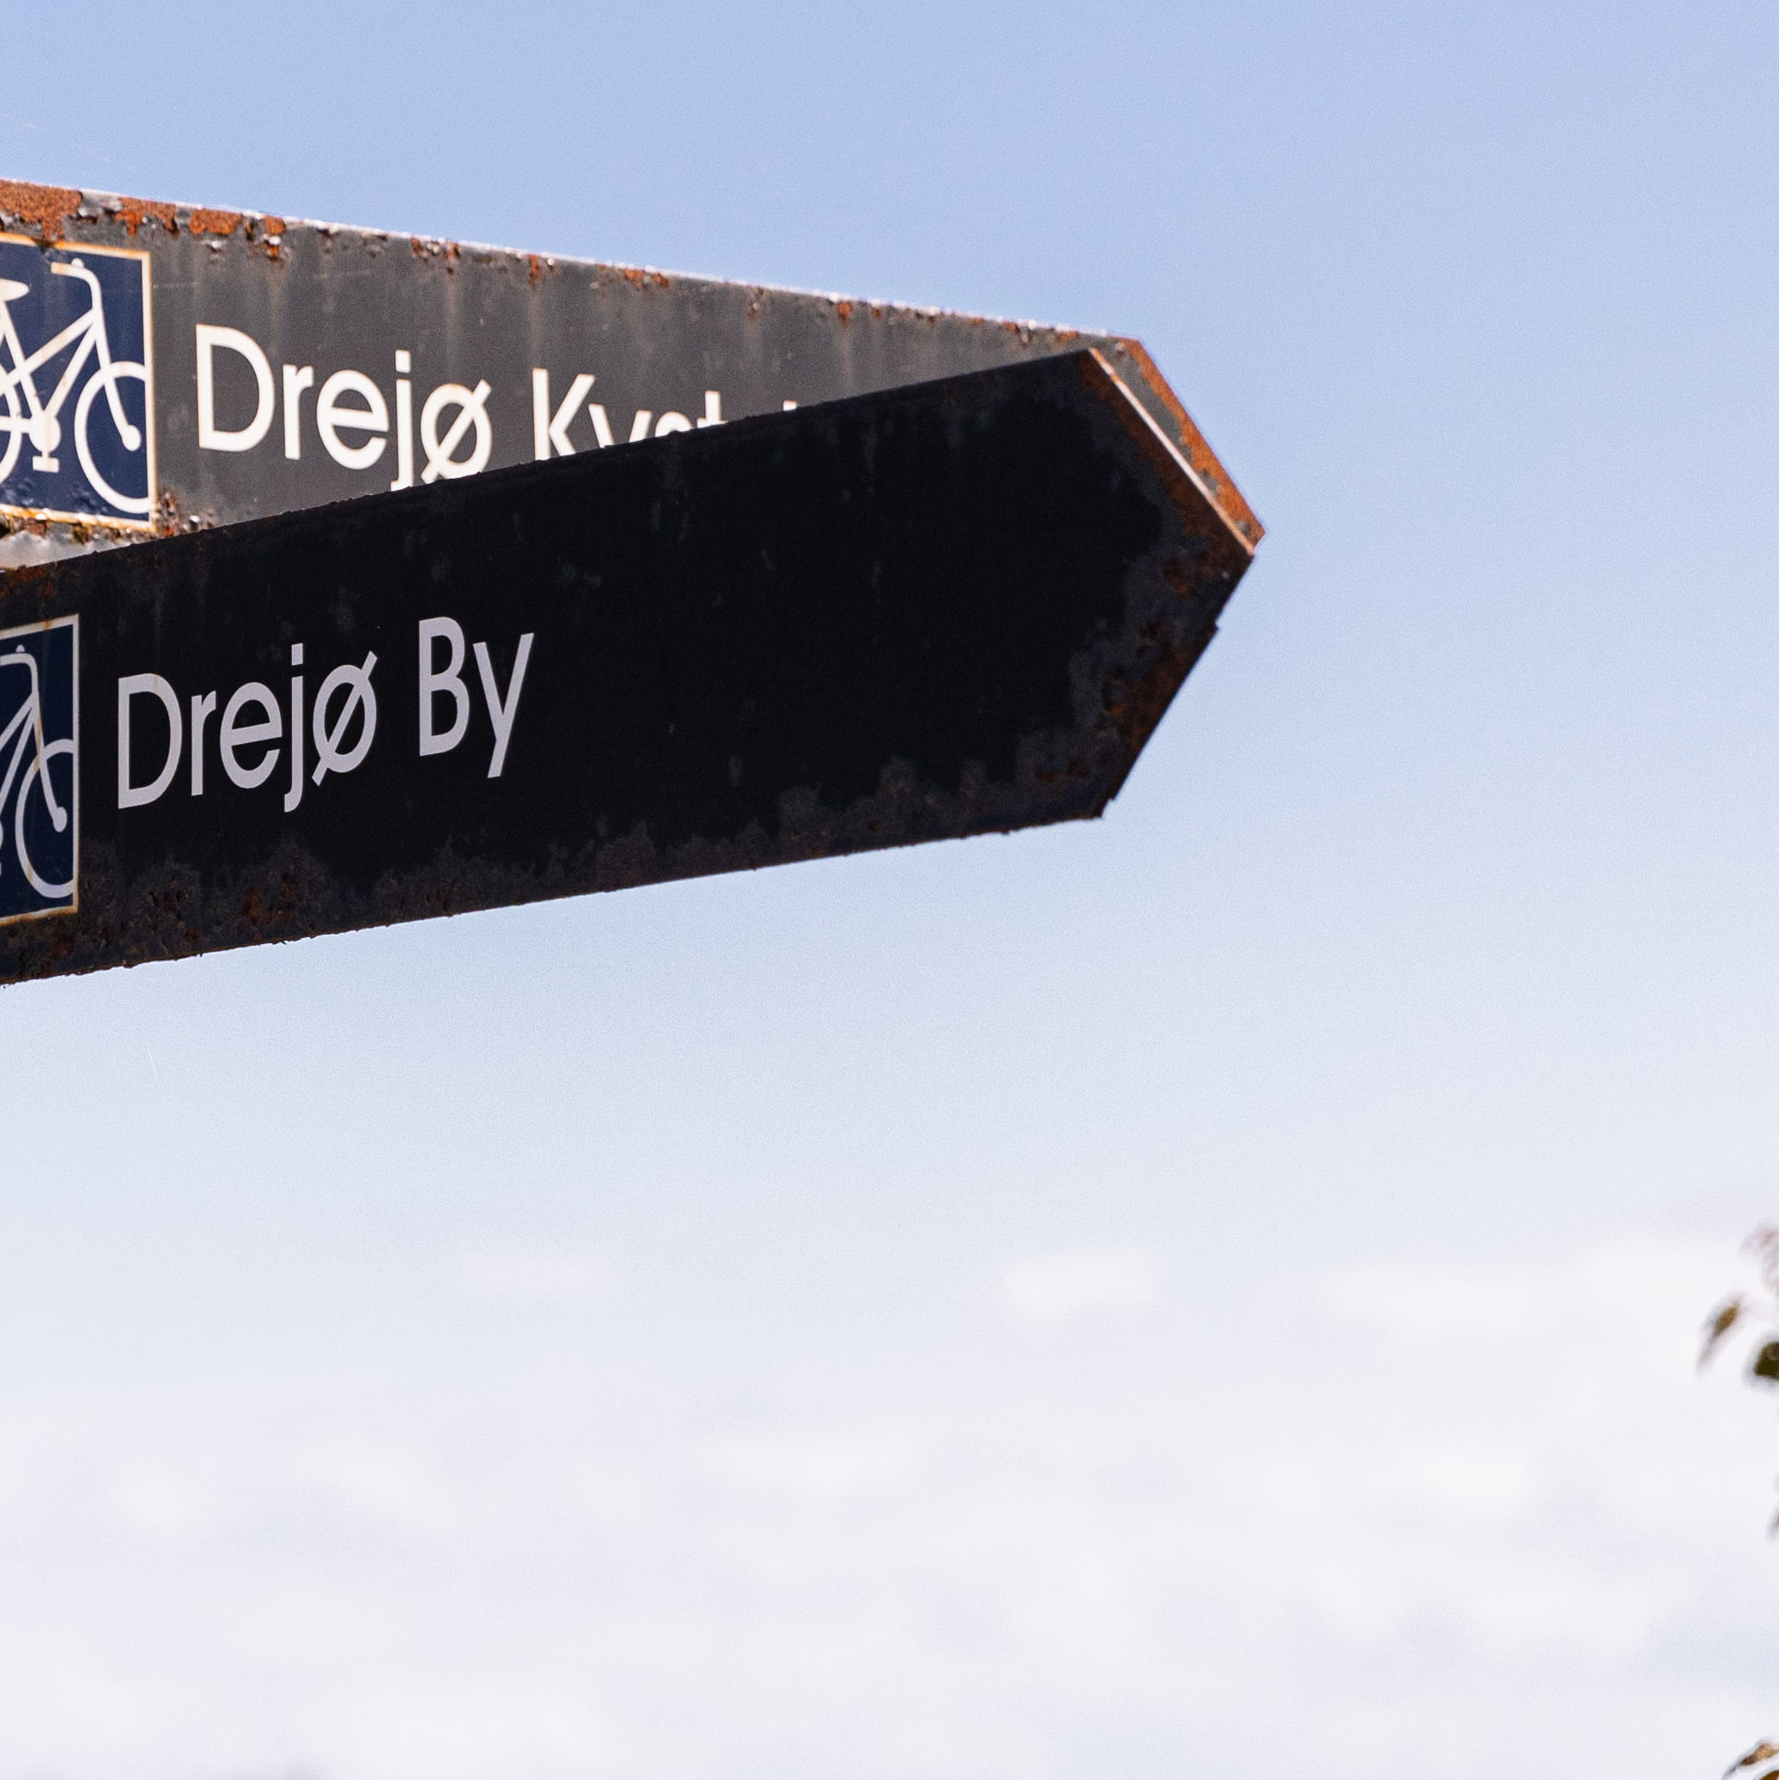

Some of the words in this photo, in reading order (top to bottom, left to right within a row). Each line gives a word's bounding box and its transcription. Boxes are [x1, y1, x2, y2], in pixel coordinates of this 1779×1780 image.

[194, 322, 494, 492] Drejø
[117, 641, 379, 814] Drejø
[418, 615, 536, 780] By
